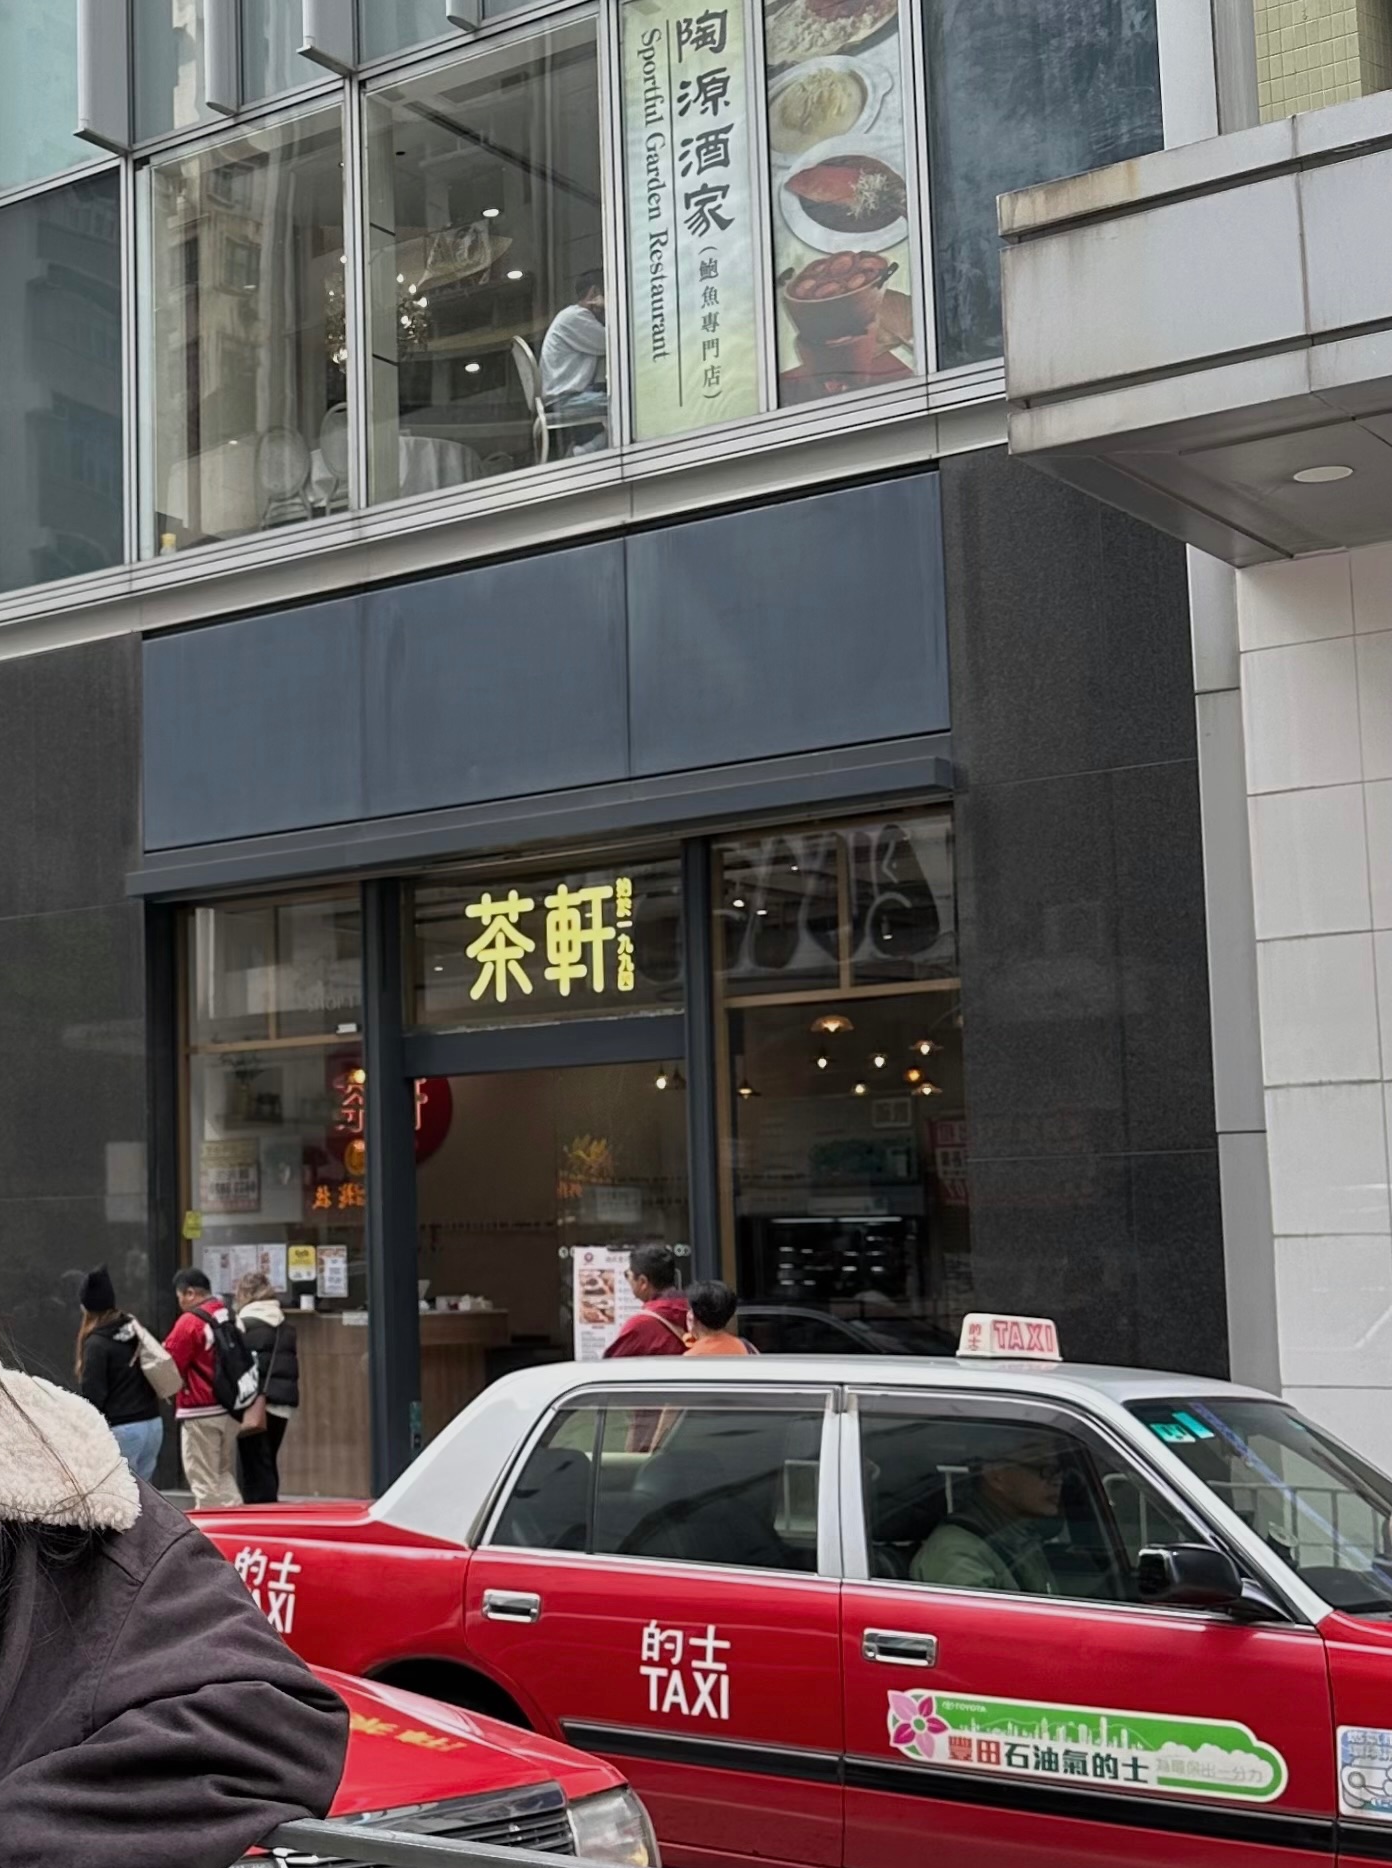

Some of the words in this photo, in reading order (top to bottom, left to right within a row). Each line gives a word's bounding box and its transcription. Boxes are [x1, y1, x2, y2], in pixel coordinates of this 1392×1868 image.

[637, 27, 665, 128] Sportful
[675, 9, 736, 238] 陶源酒家
[645, 132, 667, 222] Garden
[649, 227, 671, 363] Restaurant
[465, 883, 616, 1003] 茶軒
[992, 1320, 1056, 1353] TAXI
[234, 1546, 302, 1592] 的士
[251, 1588, 296, 1634] XI
[641, 1619, 731, 1671] 的士
[639, 1665, 729, 1720] TAXI
